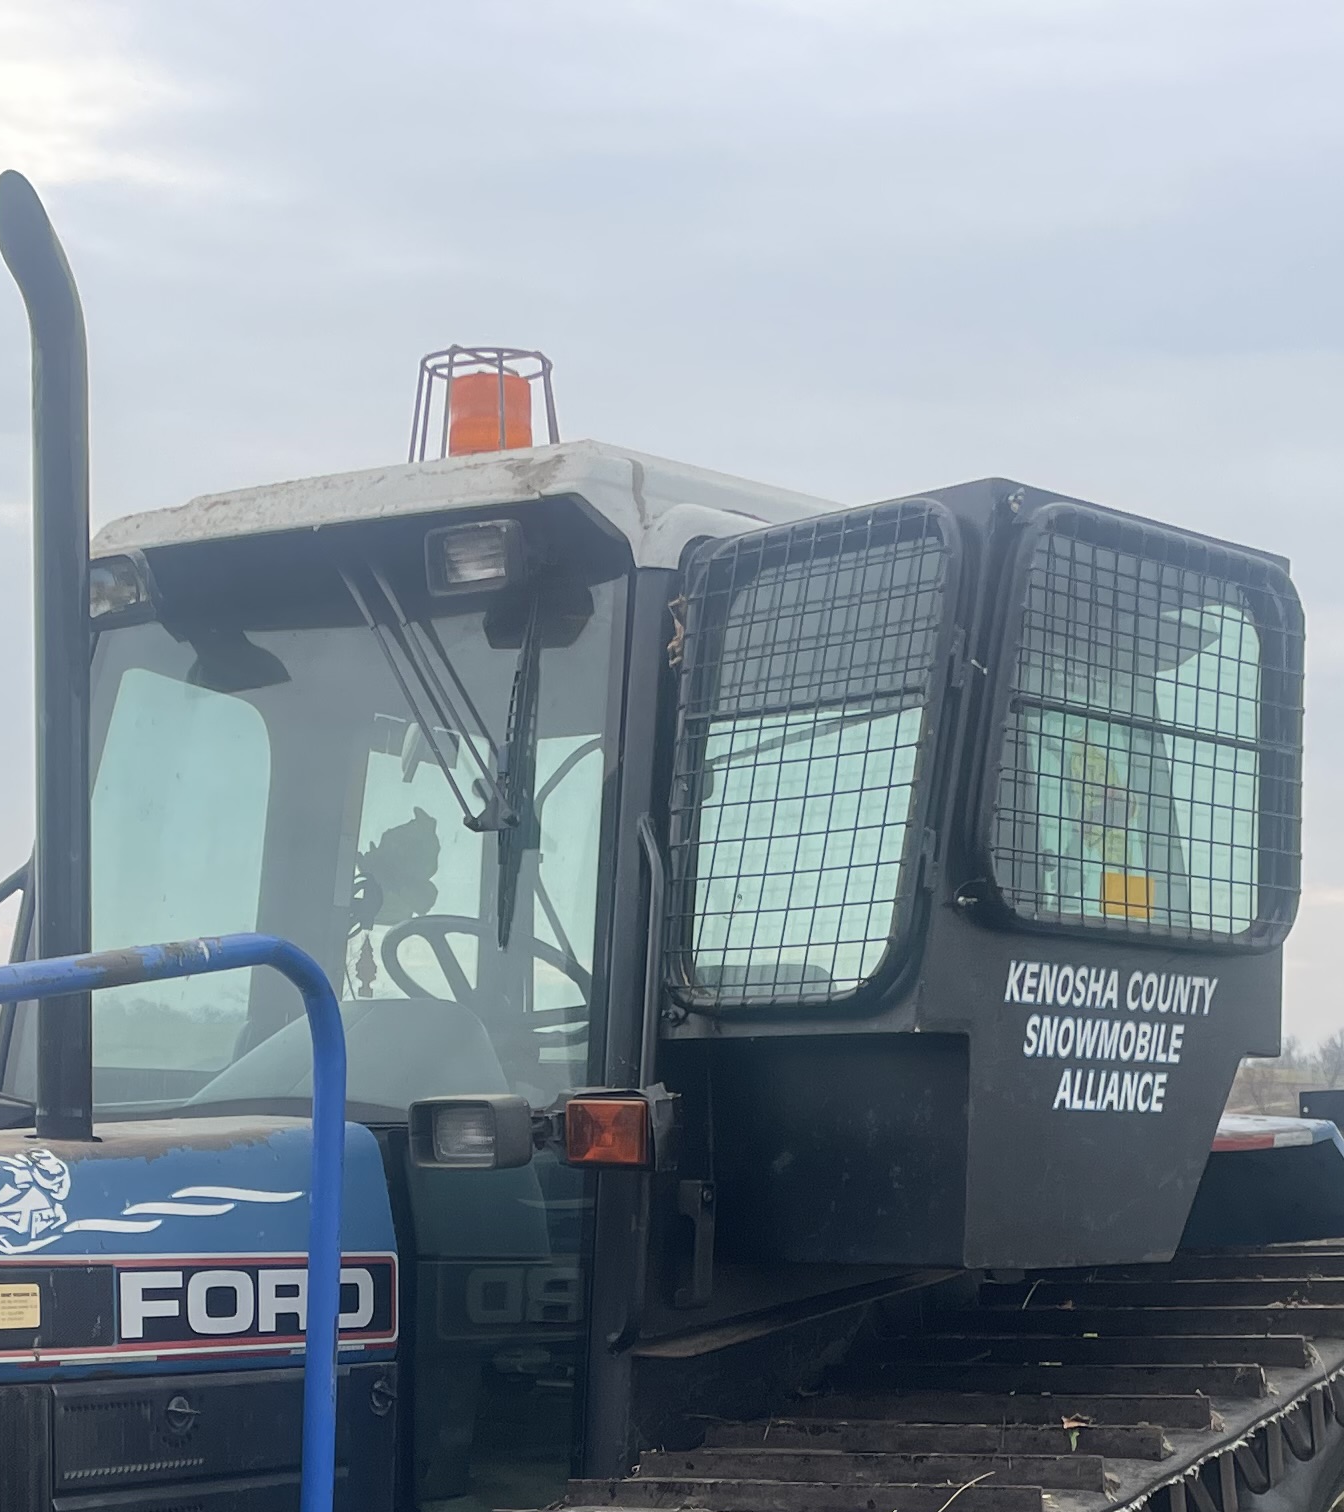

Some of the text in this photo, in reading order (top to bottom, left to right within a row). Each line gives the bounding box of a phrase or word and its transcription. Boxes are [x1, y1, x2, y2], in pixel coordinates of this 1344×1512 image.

[1004, 959, 1219, 1016] KENOSHA COUNTY
[1022, 1013, 1185, 1064] SNOWMOBILE
[1052, 1067, 1169, 1113] ALLIANCE
